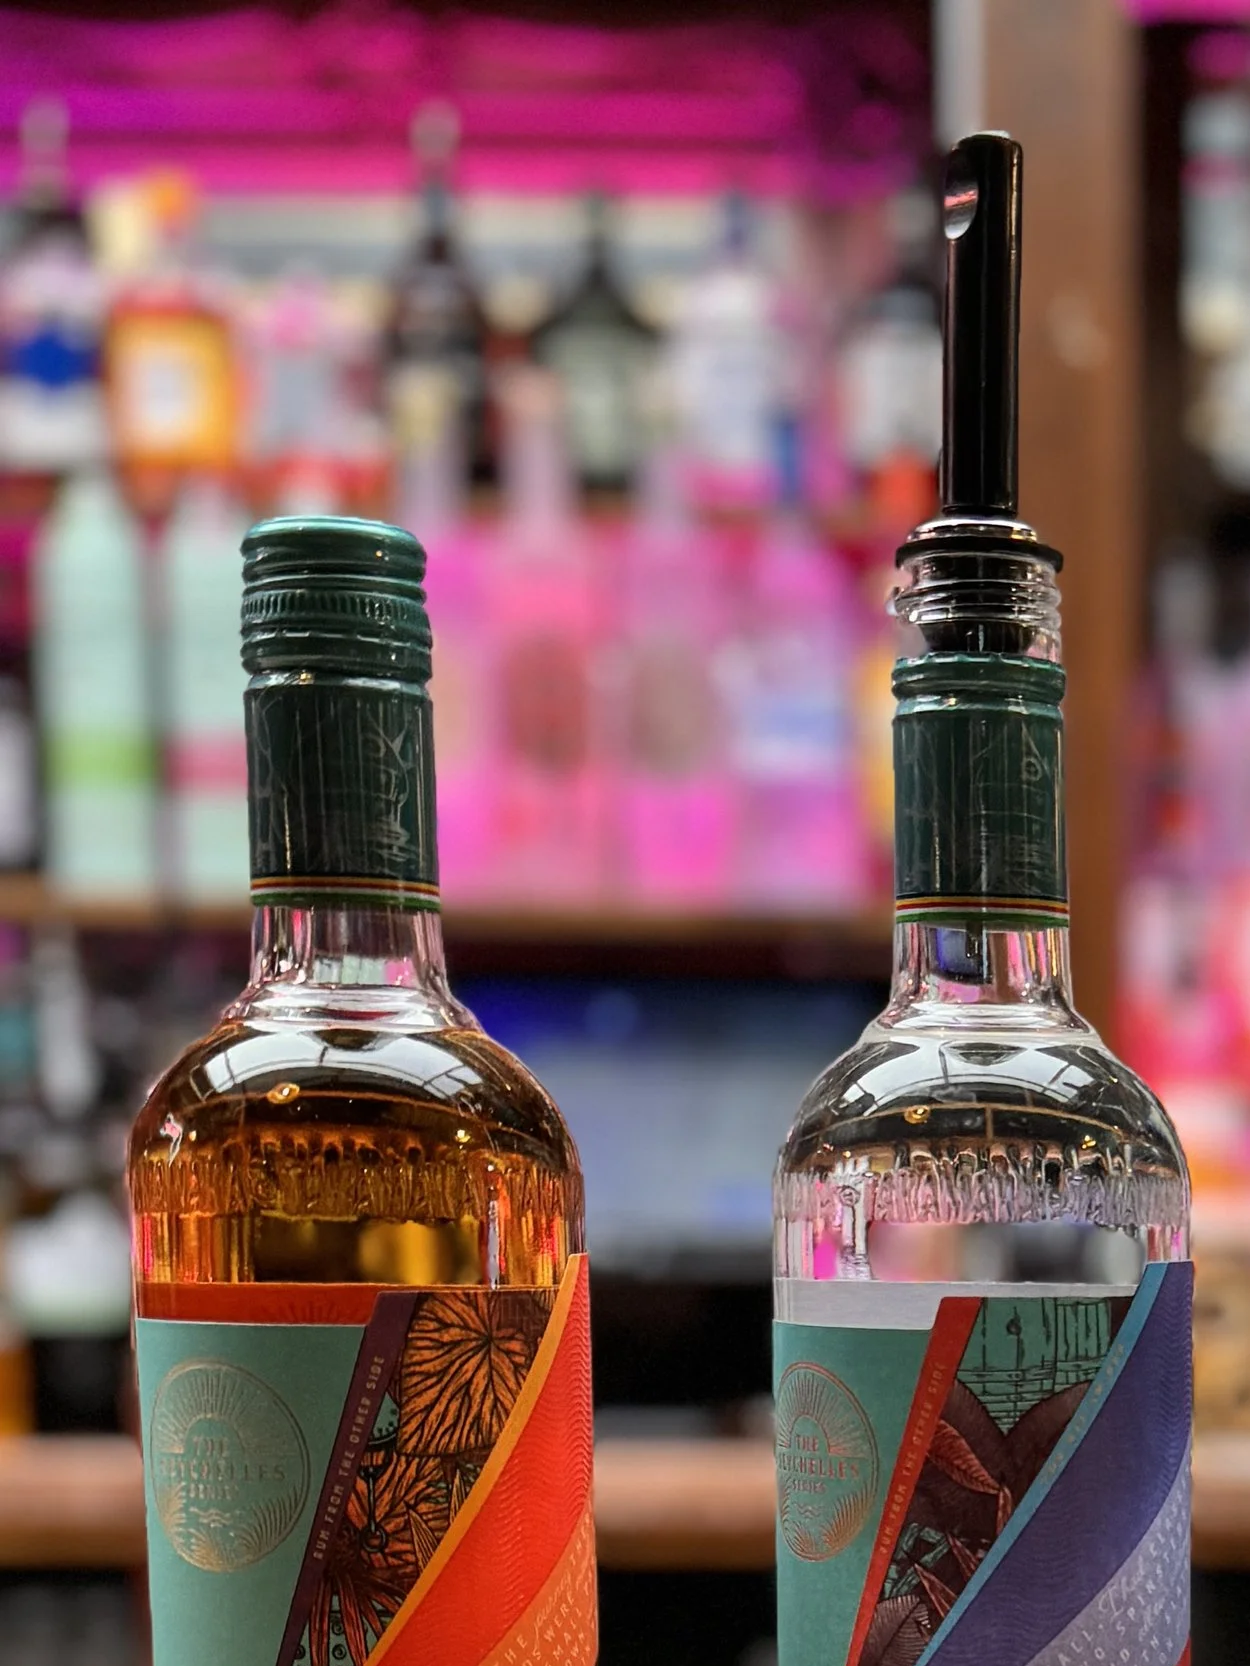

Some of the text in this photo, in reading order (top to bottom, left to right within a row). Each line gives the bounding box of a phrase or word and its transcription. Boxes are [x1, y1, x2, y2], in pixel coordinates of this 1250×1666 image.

[313, 1529, 330, 1560] RUM
[324, 1485, 344, 1524] FROM
[338, 1450, 355, 1477] THE
[349, 1396, 372, 1444] OTHER
